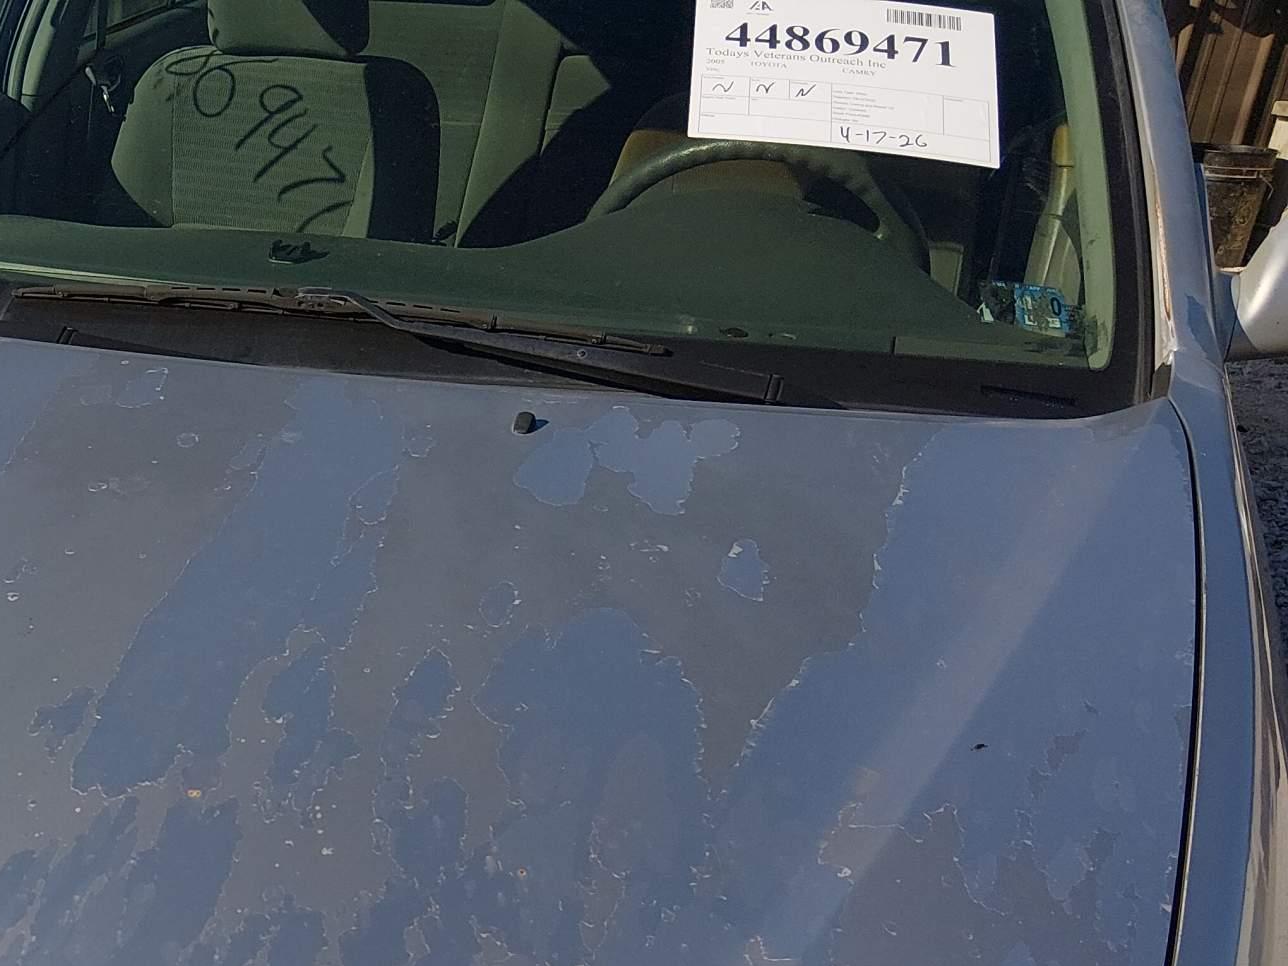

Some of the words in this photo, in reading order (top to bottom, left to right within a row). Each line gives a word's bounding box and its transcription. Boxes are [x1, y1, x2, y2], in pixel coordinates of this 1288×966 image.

[725, 22, 957, 68] 44869471
[706, 47, 750, 59] Todays
[754, 50, 807, 62] Veterans
[809, 54, 864, 67] Outreach
[868, 59, 887, 69] Inc
[751, 60, 788, 69] TOYOTA
[840, 126, 927, 147] 4-17-26
